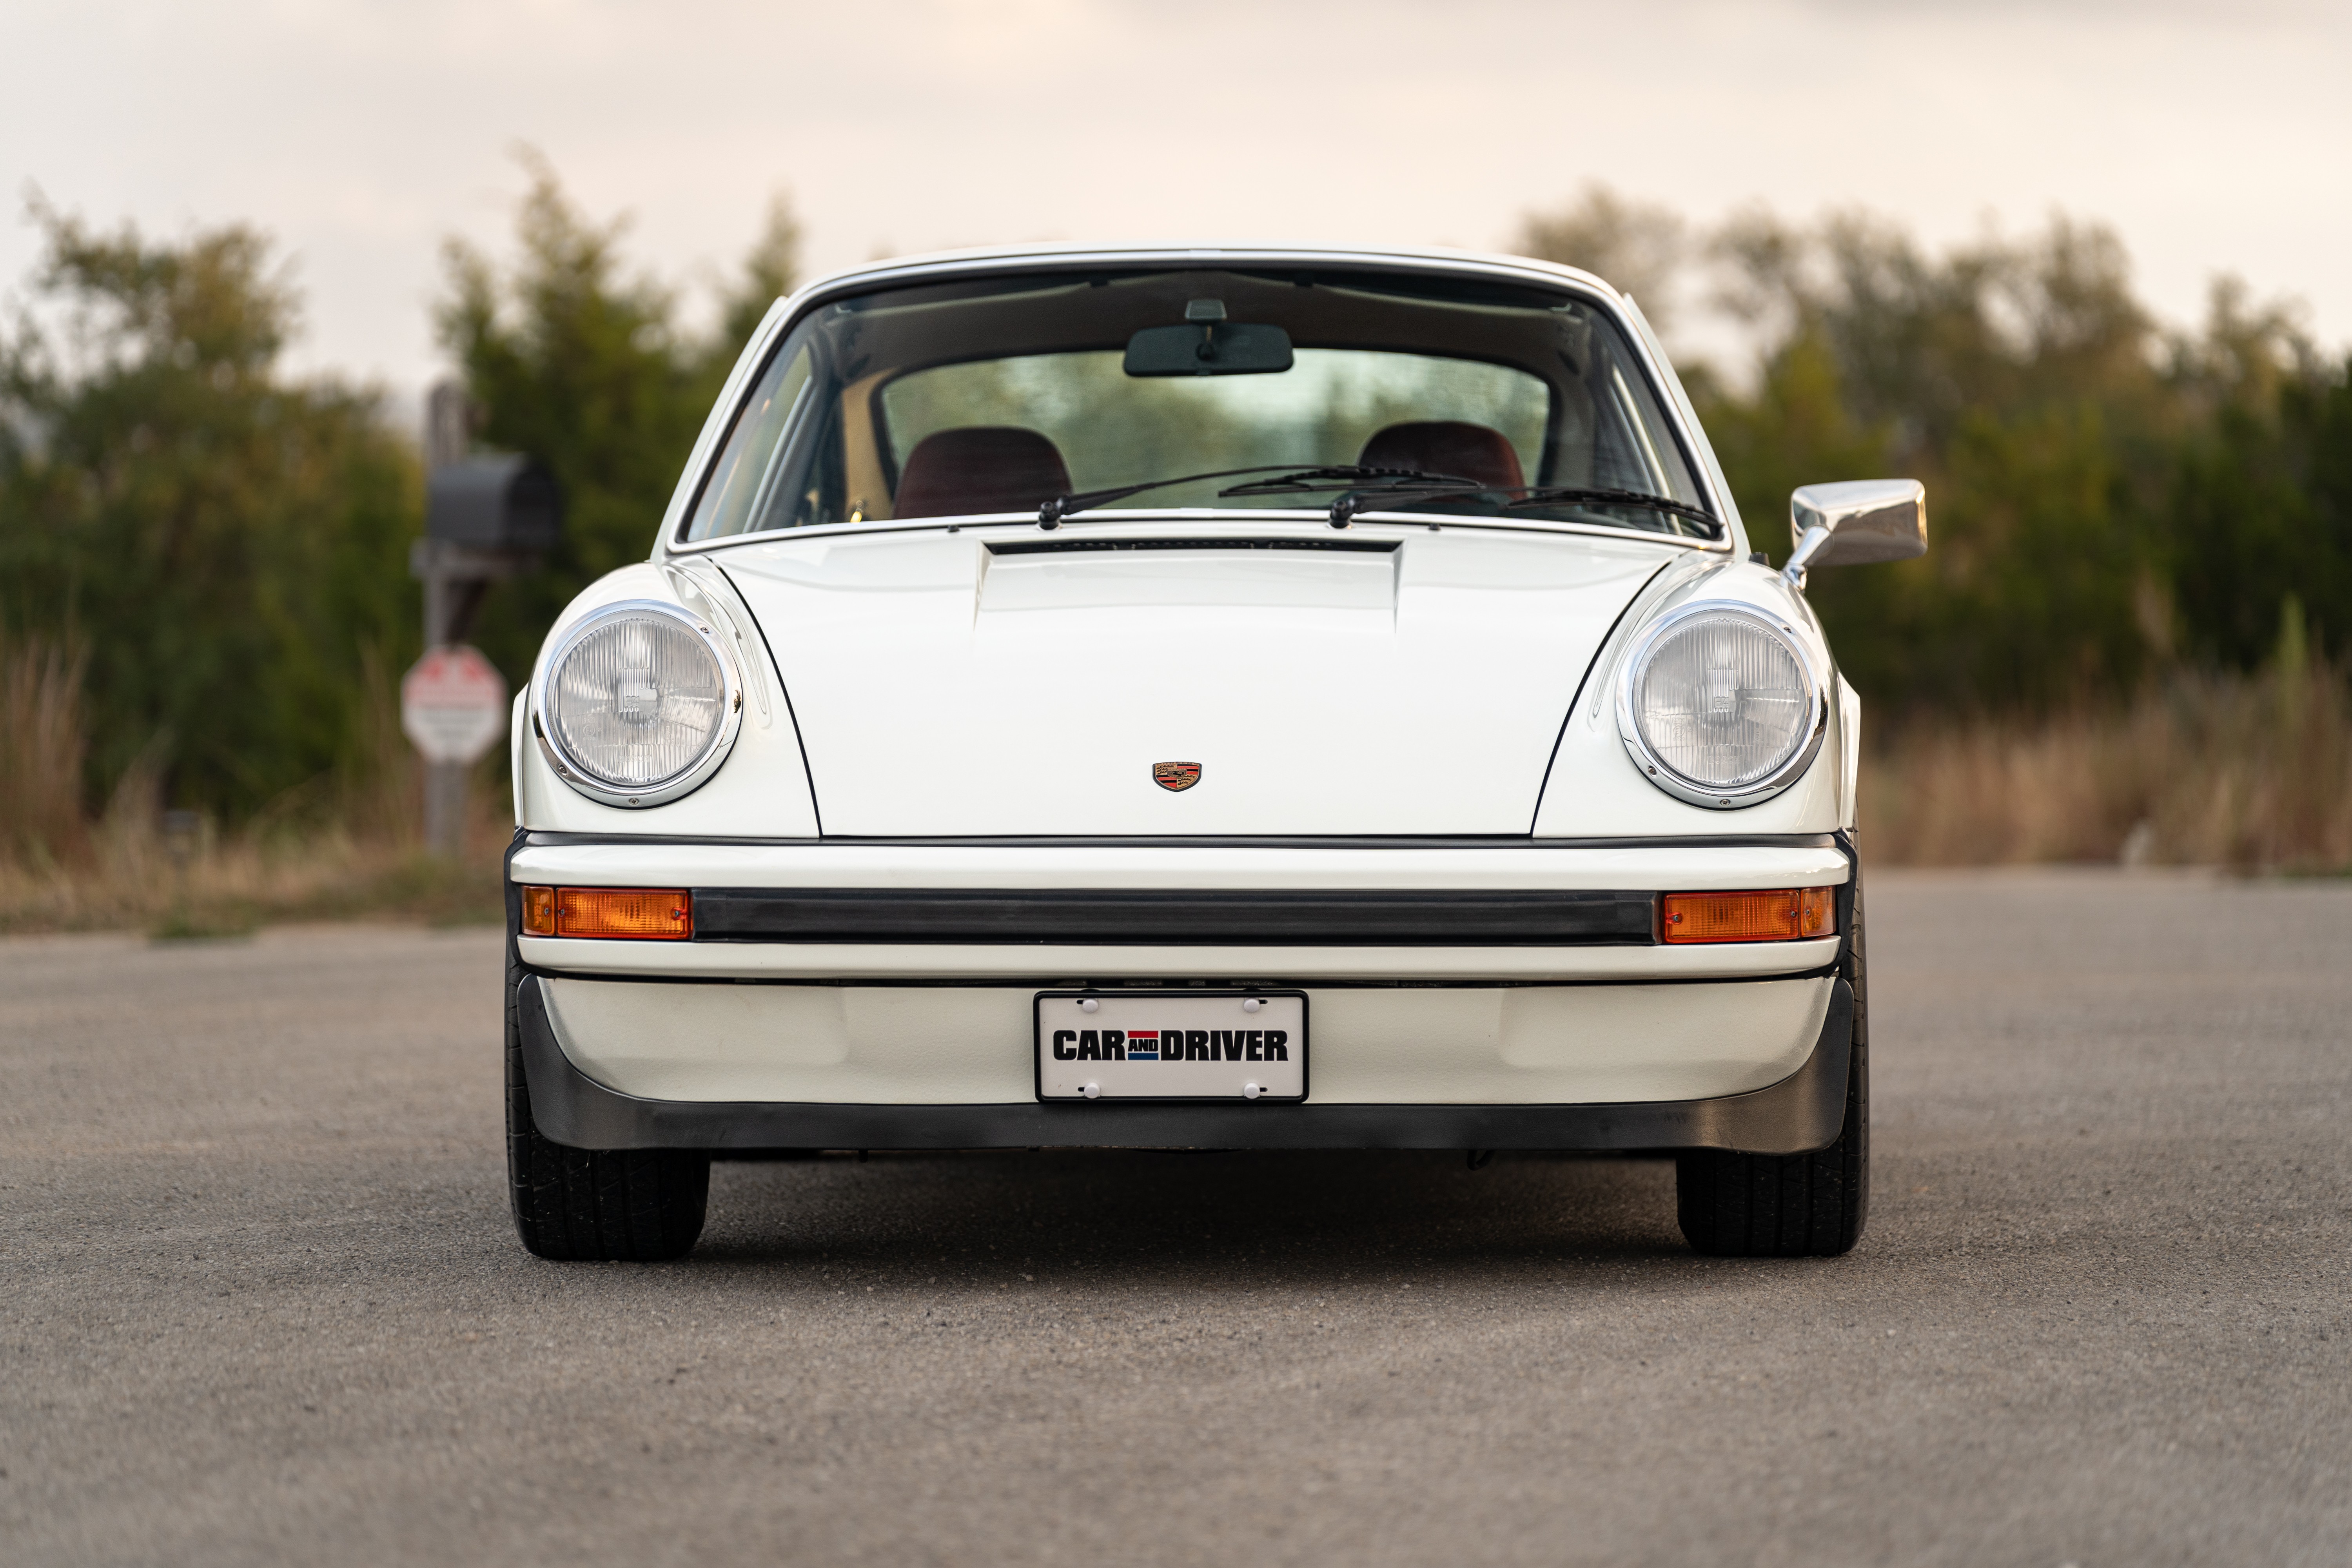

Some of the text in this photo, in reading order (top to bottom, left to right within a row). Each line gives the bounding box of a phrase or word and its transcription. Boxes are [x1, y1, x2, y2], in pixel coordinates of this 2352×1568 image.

[1709, 755, 1740, 764] BOSCH
[1053, 1030, 1289, 1061] CAR AND DRIVER
